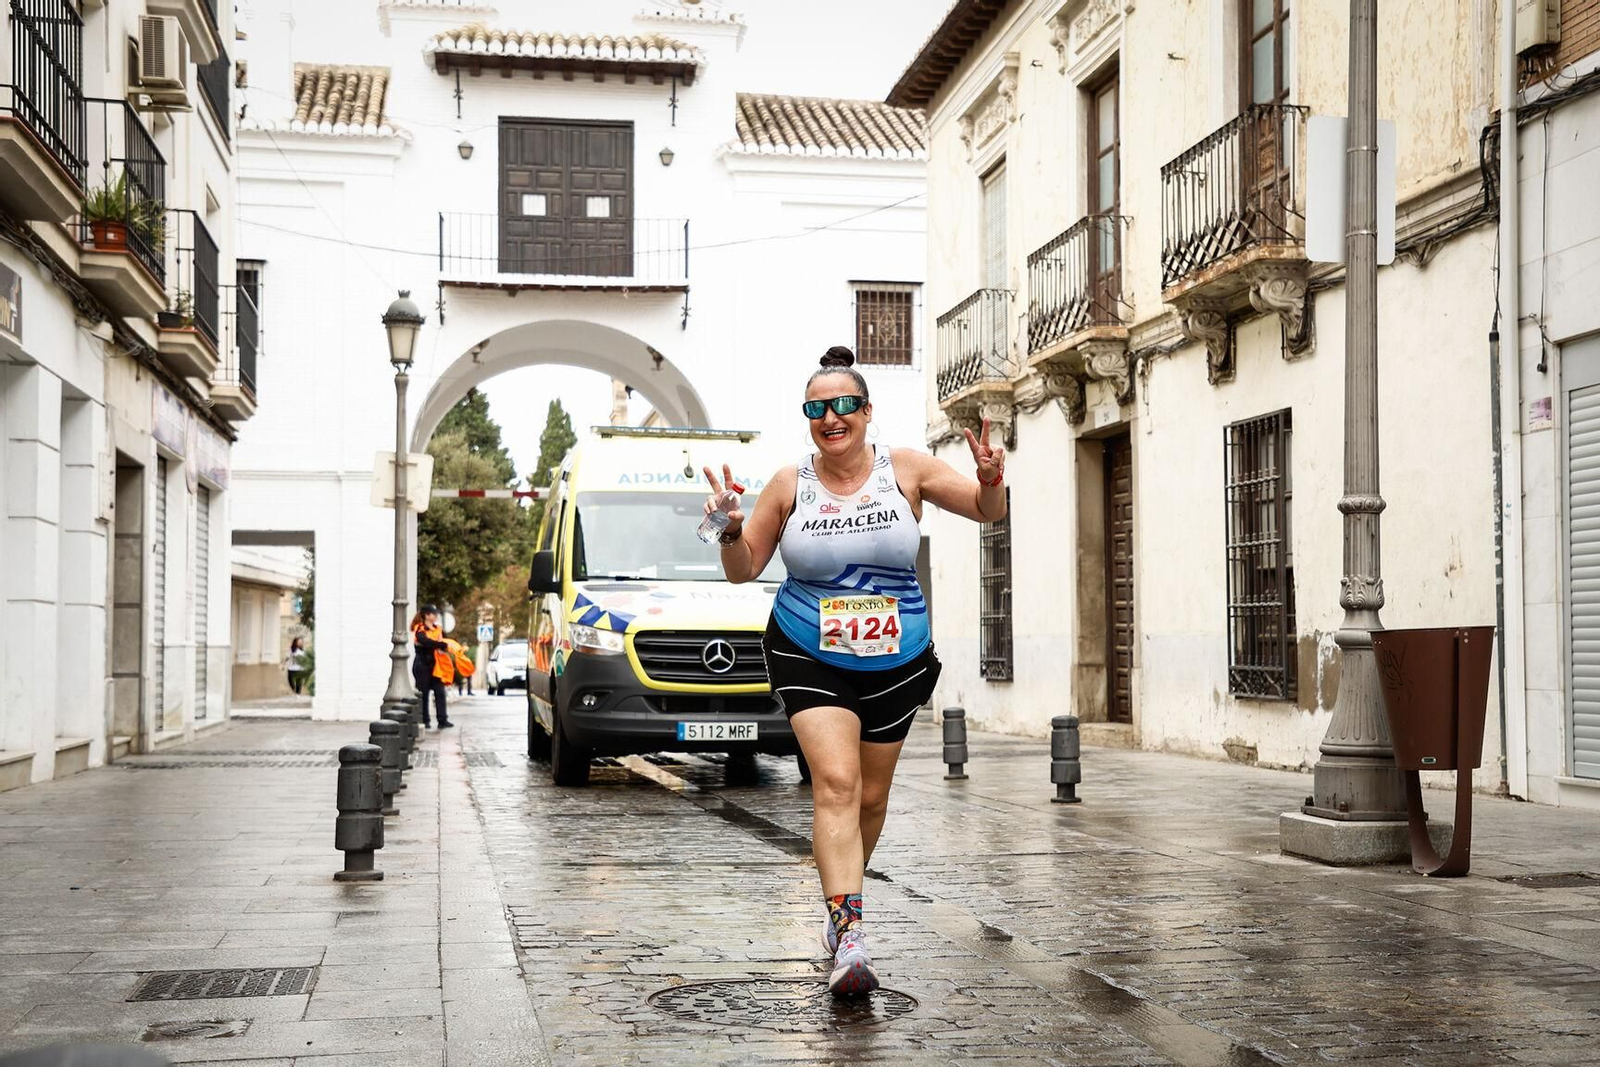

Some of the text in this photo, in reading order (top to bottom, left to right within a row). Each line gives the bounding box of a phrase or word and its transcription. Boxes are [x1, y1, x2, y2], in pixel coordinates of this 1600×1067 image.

[801, 510, 900, 531] MARACENA
[847, 524, 892, 534] ATLETISMO
[823, 615, 899, 641] 2124
[688, 725, 755, 738] 5112 MRF
